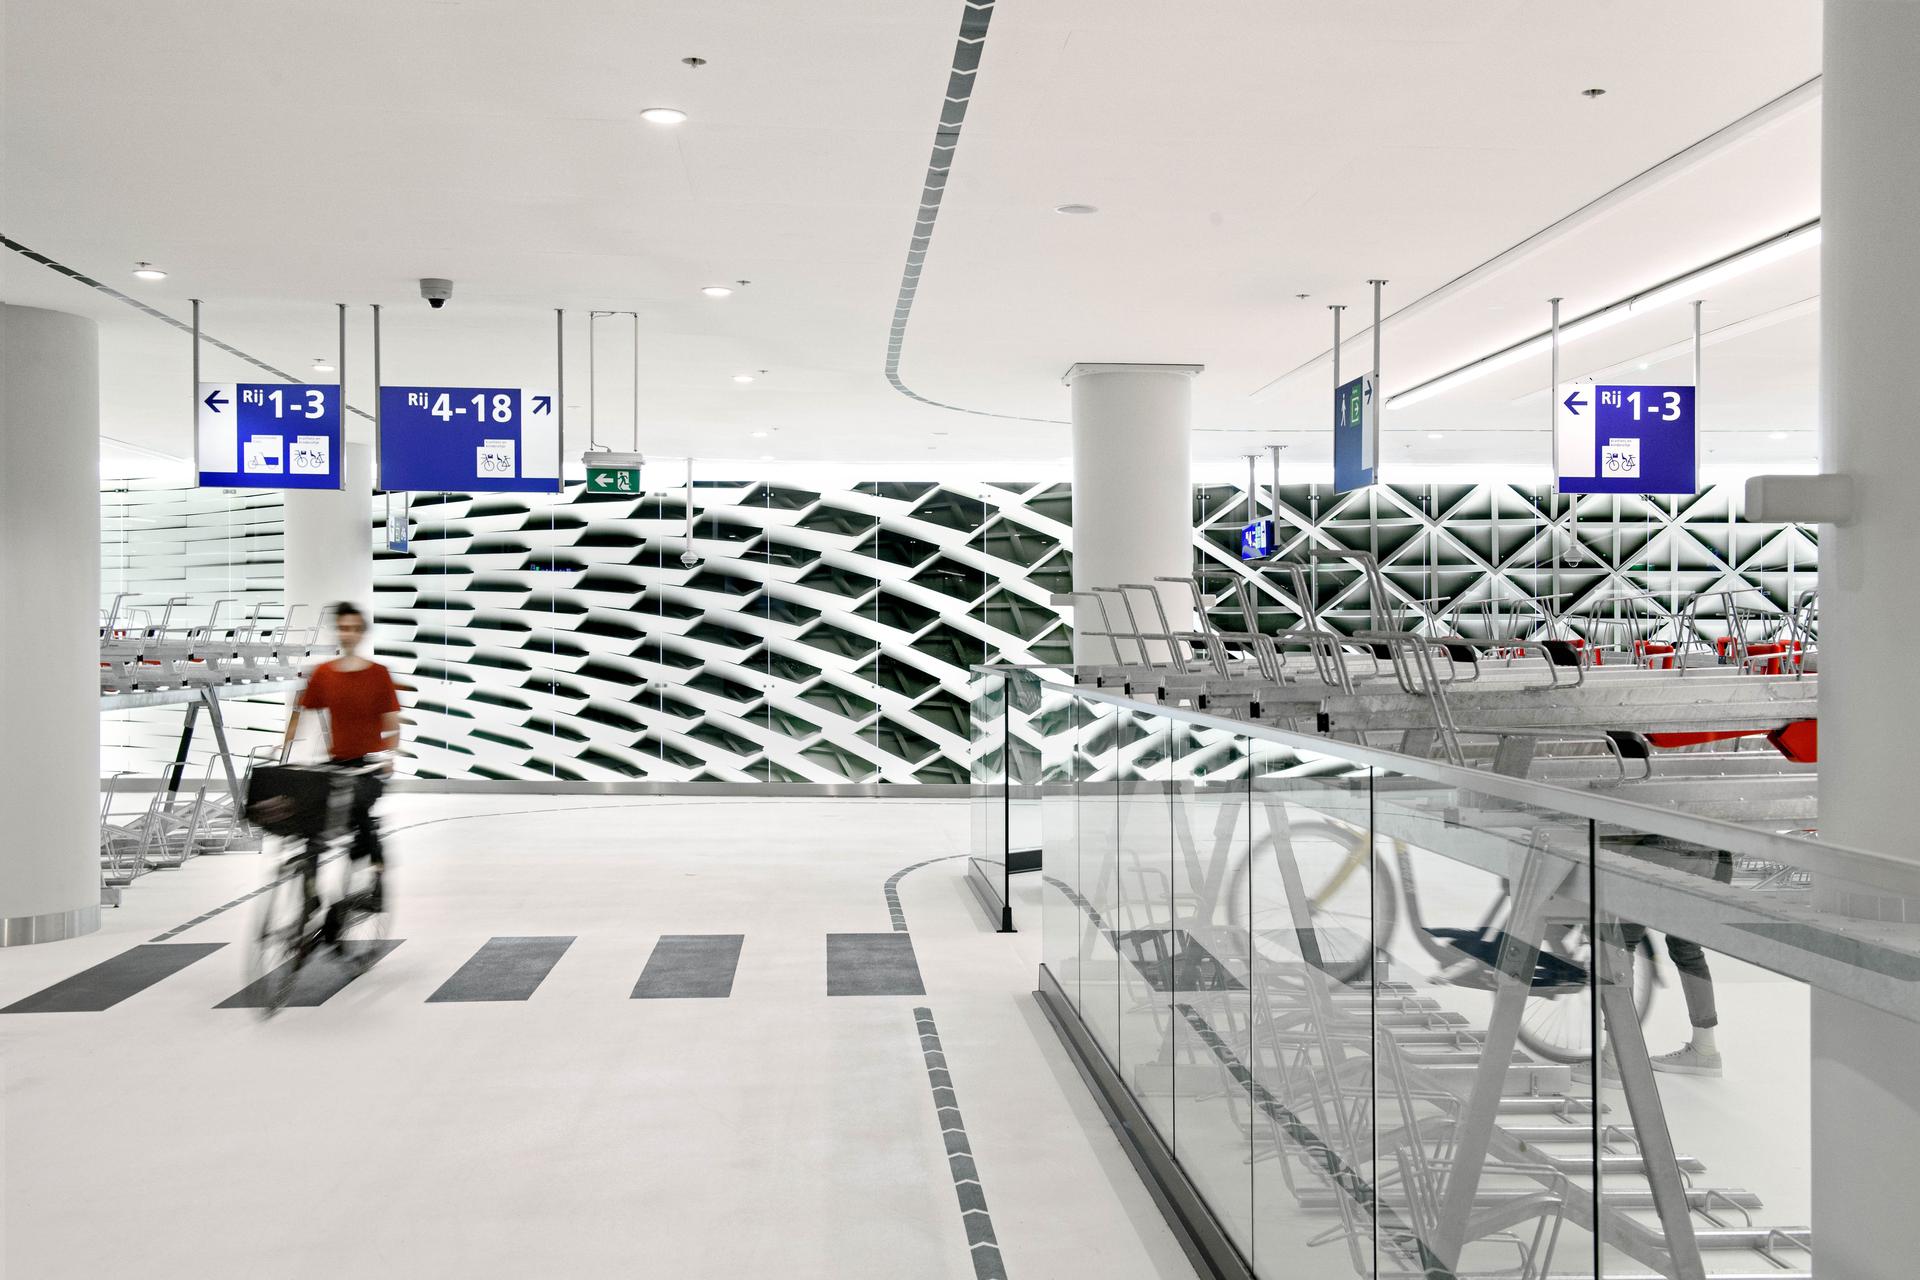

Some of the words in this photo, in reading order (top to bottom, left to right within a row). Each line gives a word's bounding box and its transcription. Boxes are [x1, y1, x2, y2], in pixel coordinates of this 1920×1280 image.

[243, 389, 264, 407] Rij
[269, 389, 325, 419] 1-3
[408, 392, 429, 410] Rij
[431, 393, 513, 422] 4-18
[1601, 390, 1622, 408] Rij
[1626, 391, 1681, 421] 1-3
